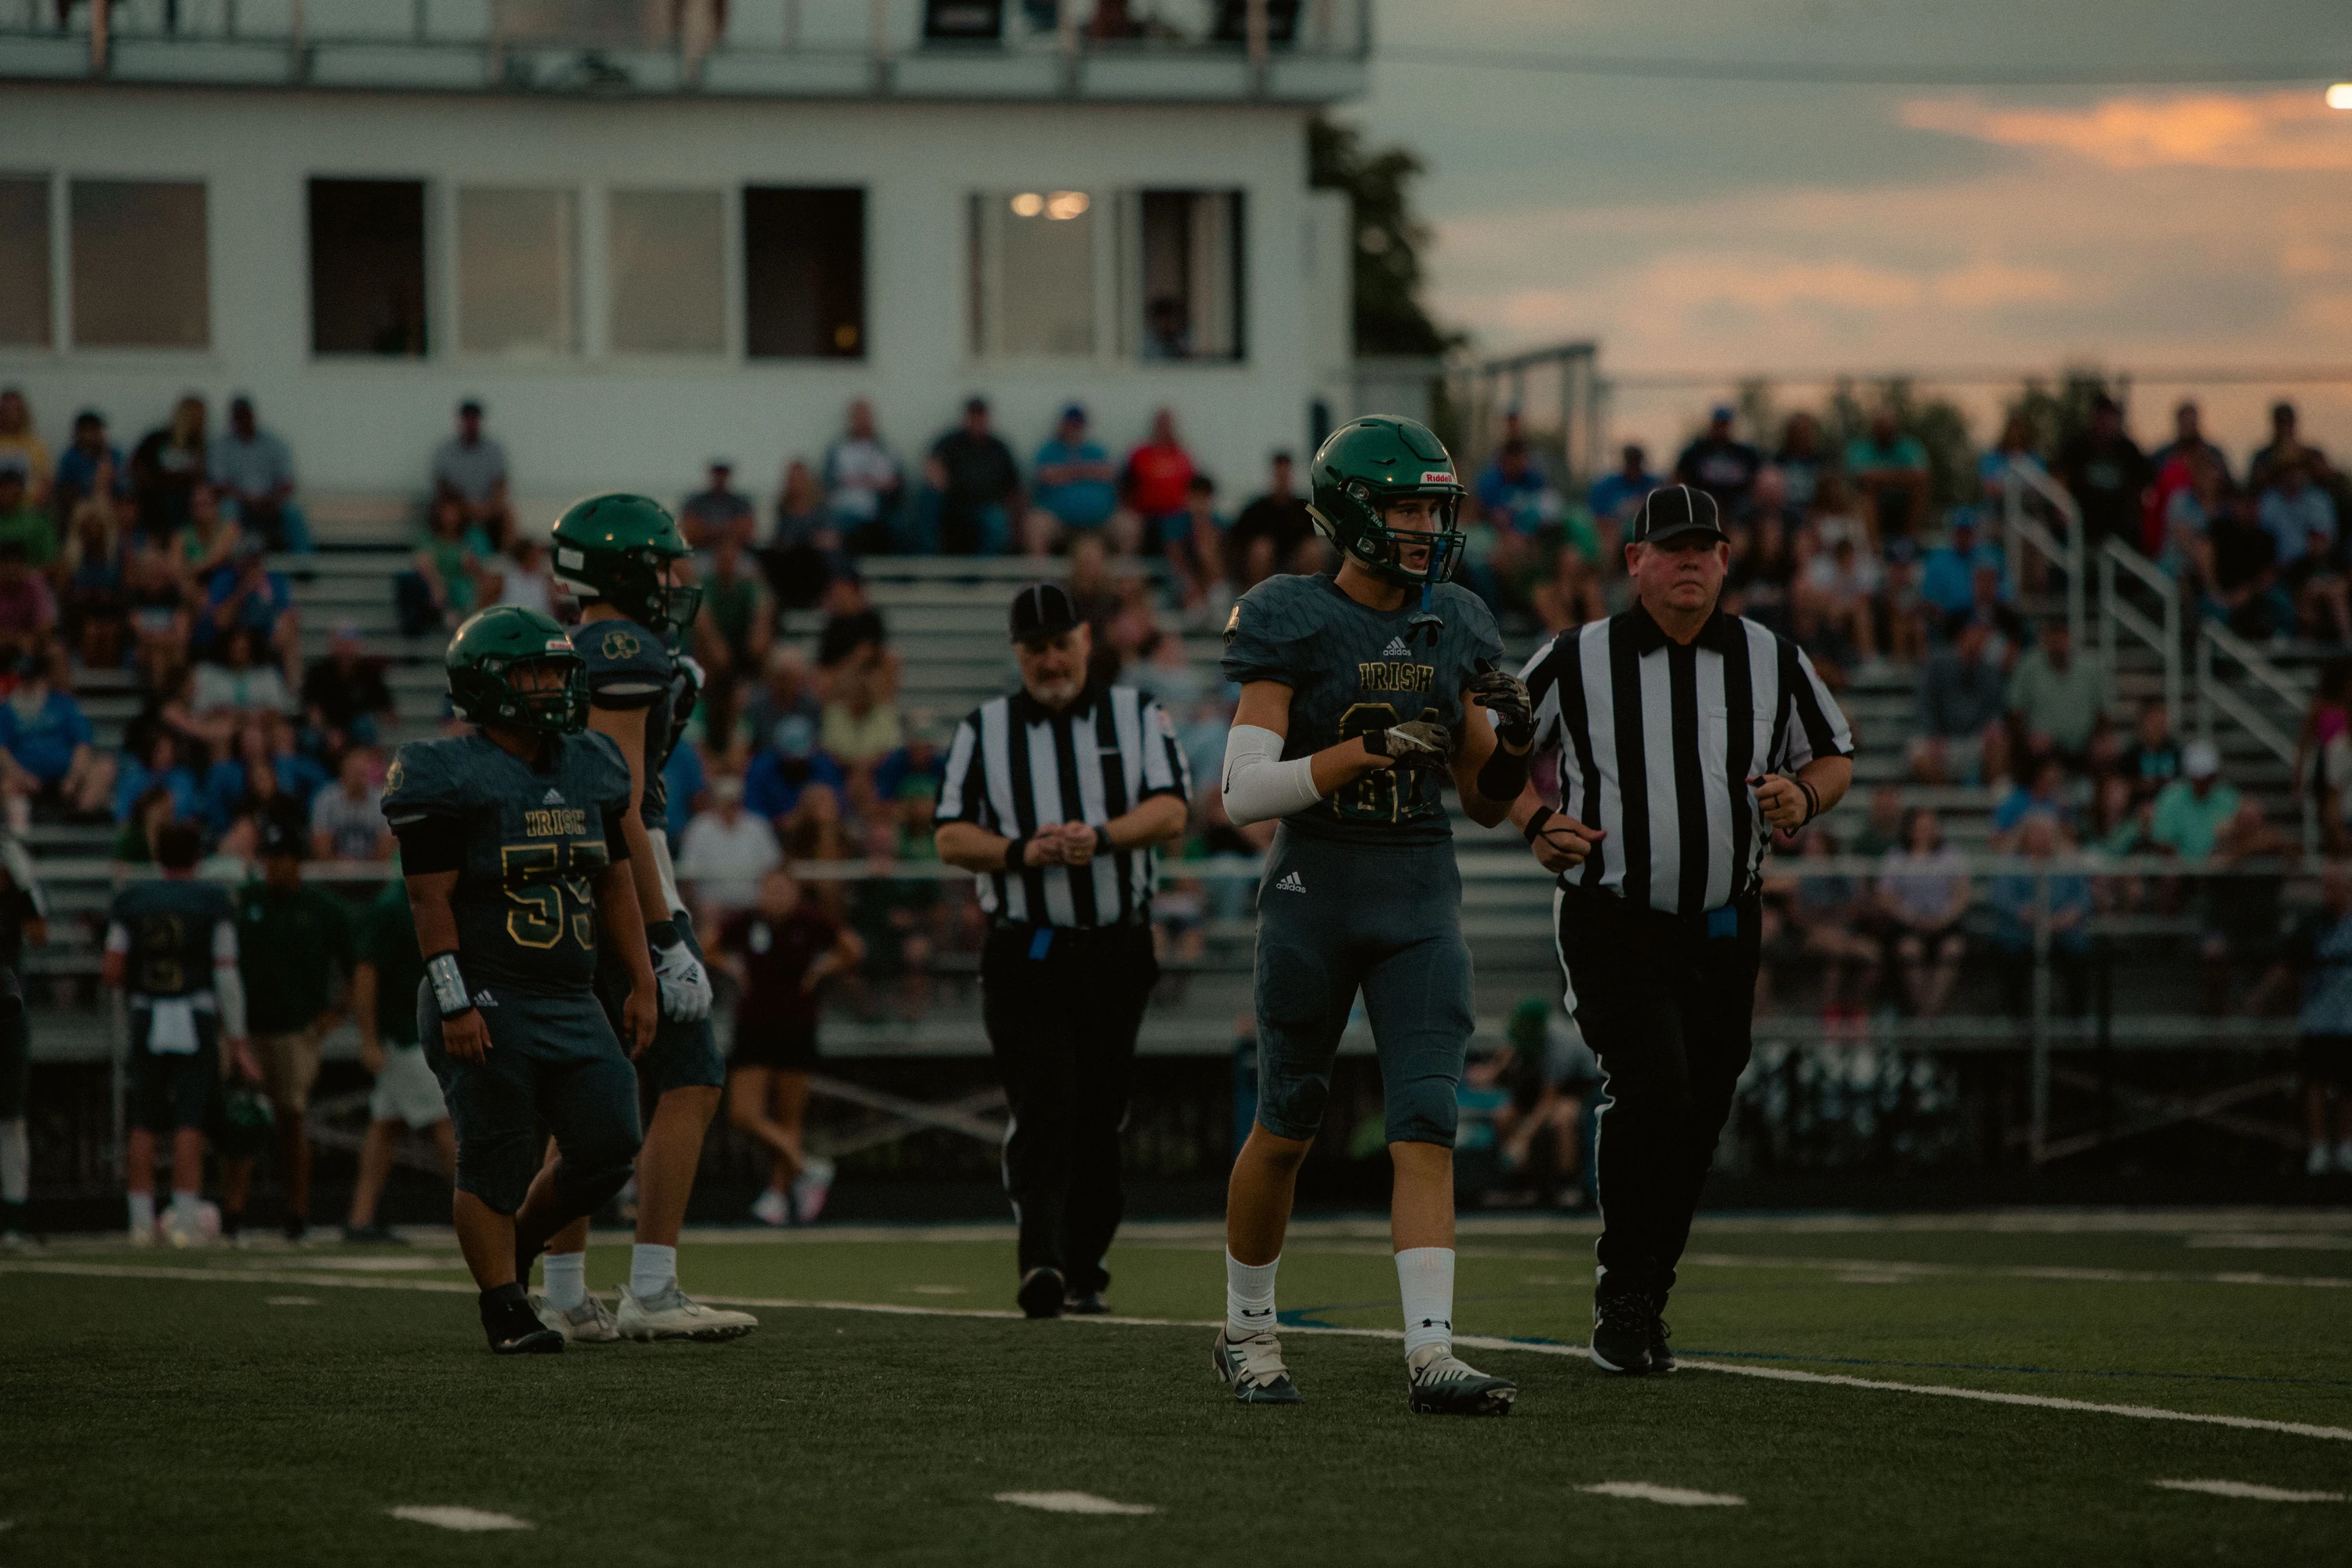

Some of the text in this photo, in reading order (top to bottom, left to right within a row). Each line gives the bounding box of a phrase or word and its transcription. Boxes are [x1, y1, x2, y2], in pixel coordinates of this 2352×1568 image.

[1426, 474, 1453, 483] Riddell
[1359, 662, 1434, 693] IRISH
[524, 808, 586, 837] IRISH
[1276, 883, 1306, 894] adidas
